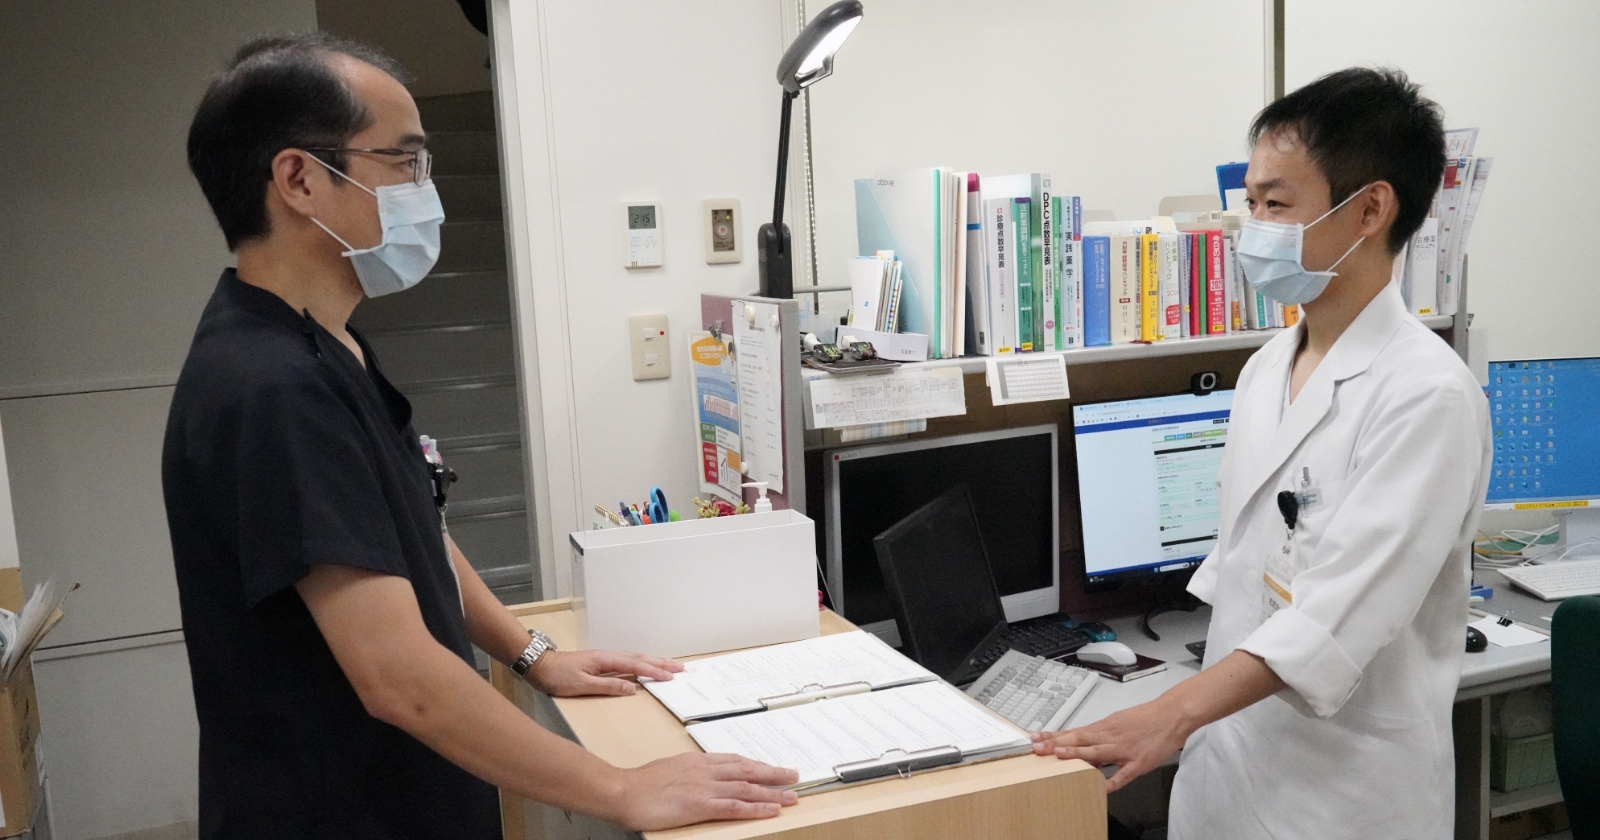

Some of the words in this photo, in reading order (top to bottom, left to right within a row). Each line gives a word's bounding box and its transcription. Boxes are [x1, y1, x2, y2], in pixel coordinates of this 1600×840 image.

[996, 214, 1005, 268] 診療点数早見表
[1043, 192, 1051, 266] DPC点数早見表
[1065, 231, 1074, 279] 実践薬学
[1212, 235, 1222, 279] 今日の治療薬
[1416, 251, 1436, 260] 2025
